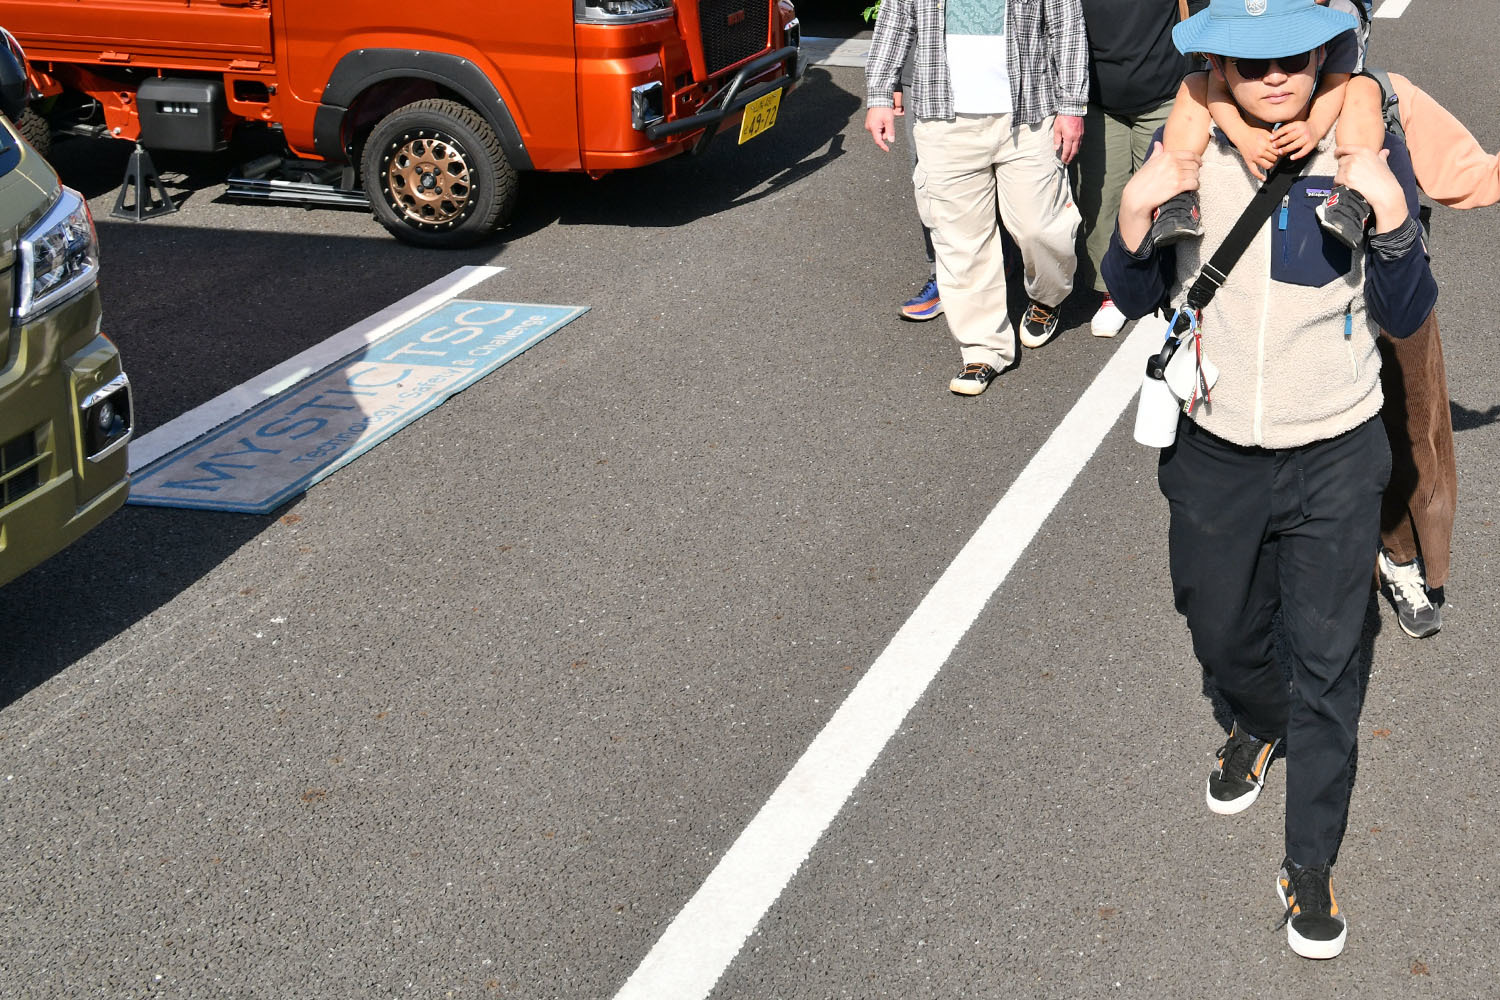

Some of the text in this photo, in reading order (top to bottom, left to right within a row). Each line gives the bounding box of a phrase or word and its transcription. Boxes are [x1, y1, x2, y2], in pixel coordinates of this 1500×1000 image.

[159, 305, 516, 492] MYSTIC TSC
[397, 367, 466, 404] Safety
[467, 313, 547, 361] Challenge
